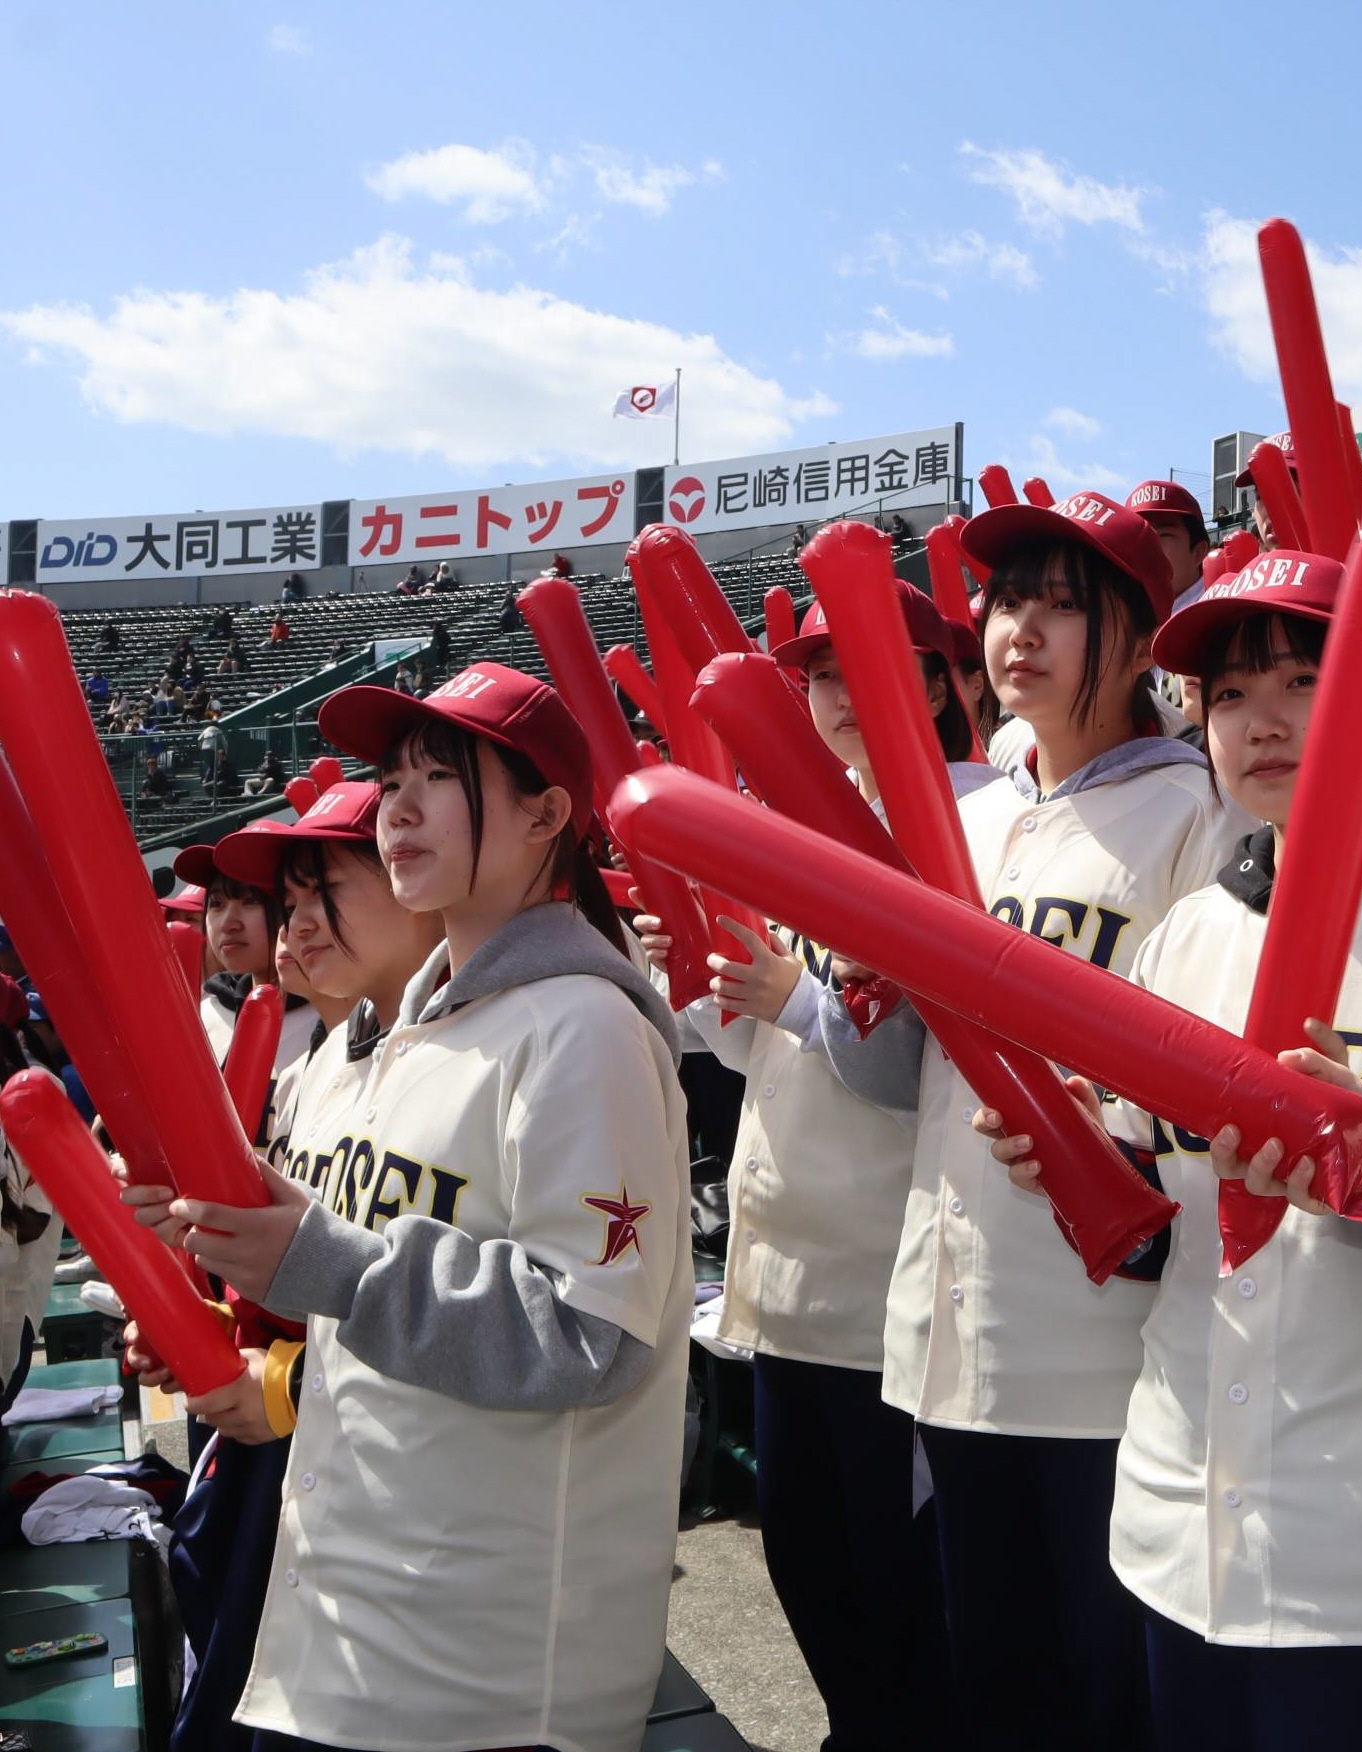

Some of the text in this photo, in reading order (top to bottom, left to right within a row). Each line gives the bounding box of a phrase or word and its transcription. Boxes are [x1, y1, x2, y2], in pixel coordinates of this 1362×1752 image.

[715, 441, 950, 516] 尼崎信用金庫
[1131, 485, 1167, 508] KOSEI
[359, 479, 625, 559] カニトップ
[1048, 496, 1116, 527] OSEI
[124, 512, 317, 572] 大同工業
